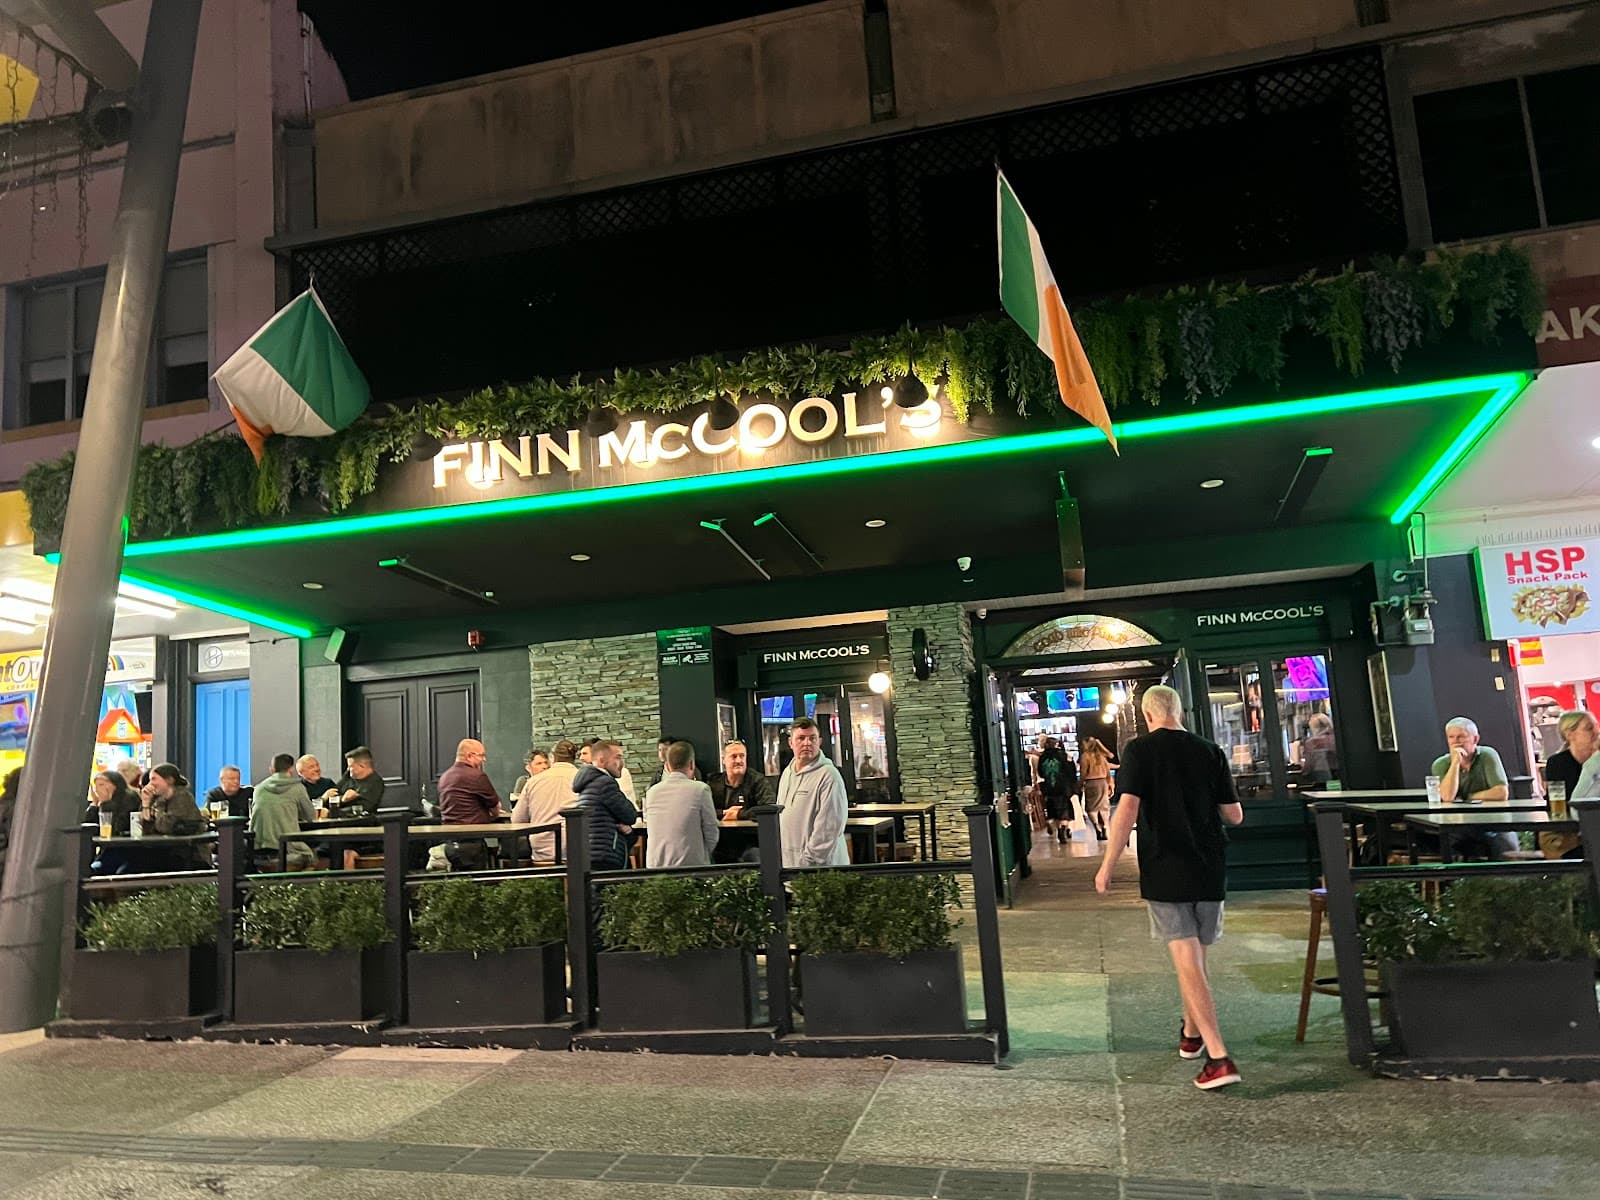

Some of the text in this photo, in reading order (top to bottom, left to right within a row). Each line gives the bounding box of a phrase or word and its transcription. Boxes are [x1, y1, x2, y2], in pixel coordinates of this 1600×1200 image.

[432, 384, 943, 488] FINN McCOOL'S
[1504, 546, 1585, 576] HSP
[1507, 571, 1589, 585] Snack Pack
[1197, 605, 1325, 626] FINN McCOOL'S
[763, 644, 870, 664] FINN McCOOL'S
